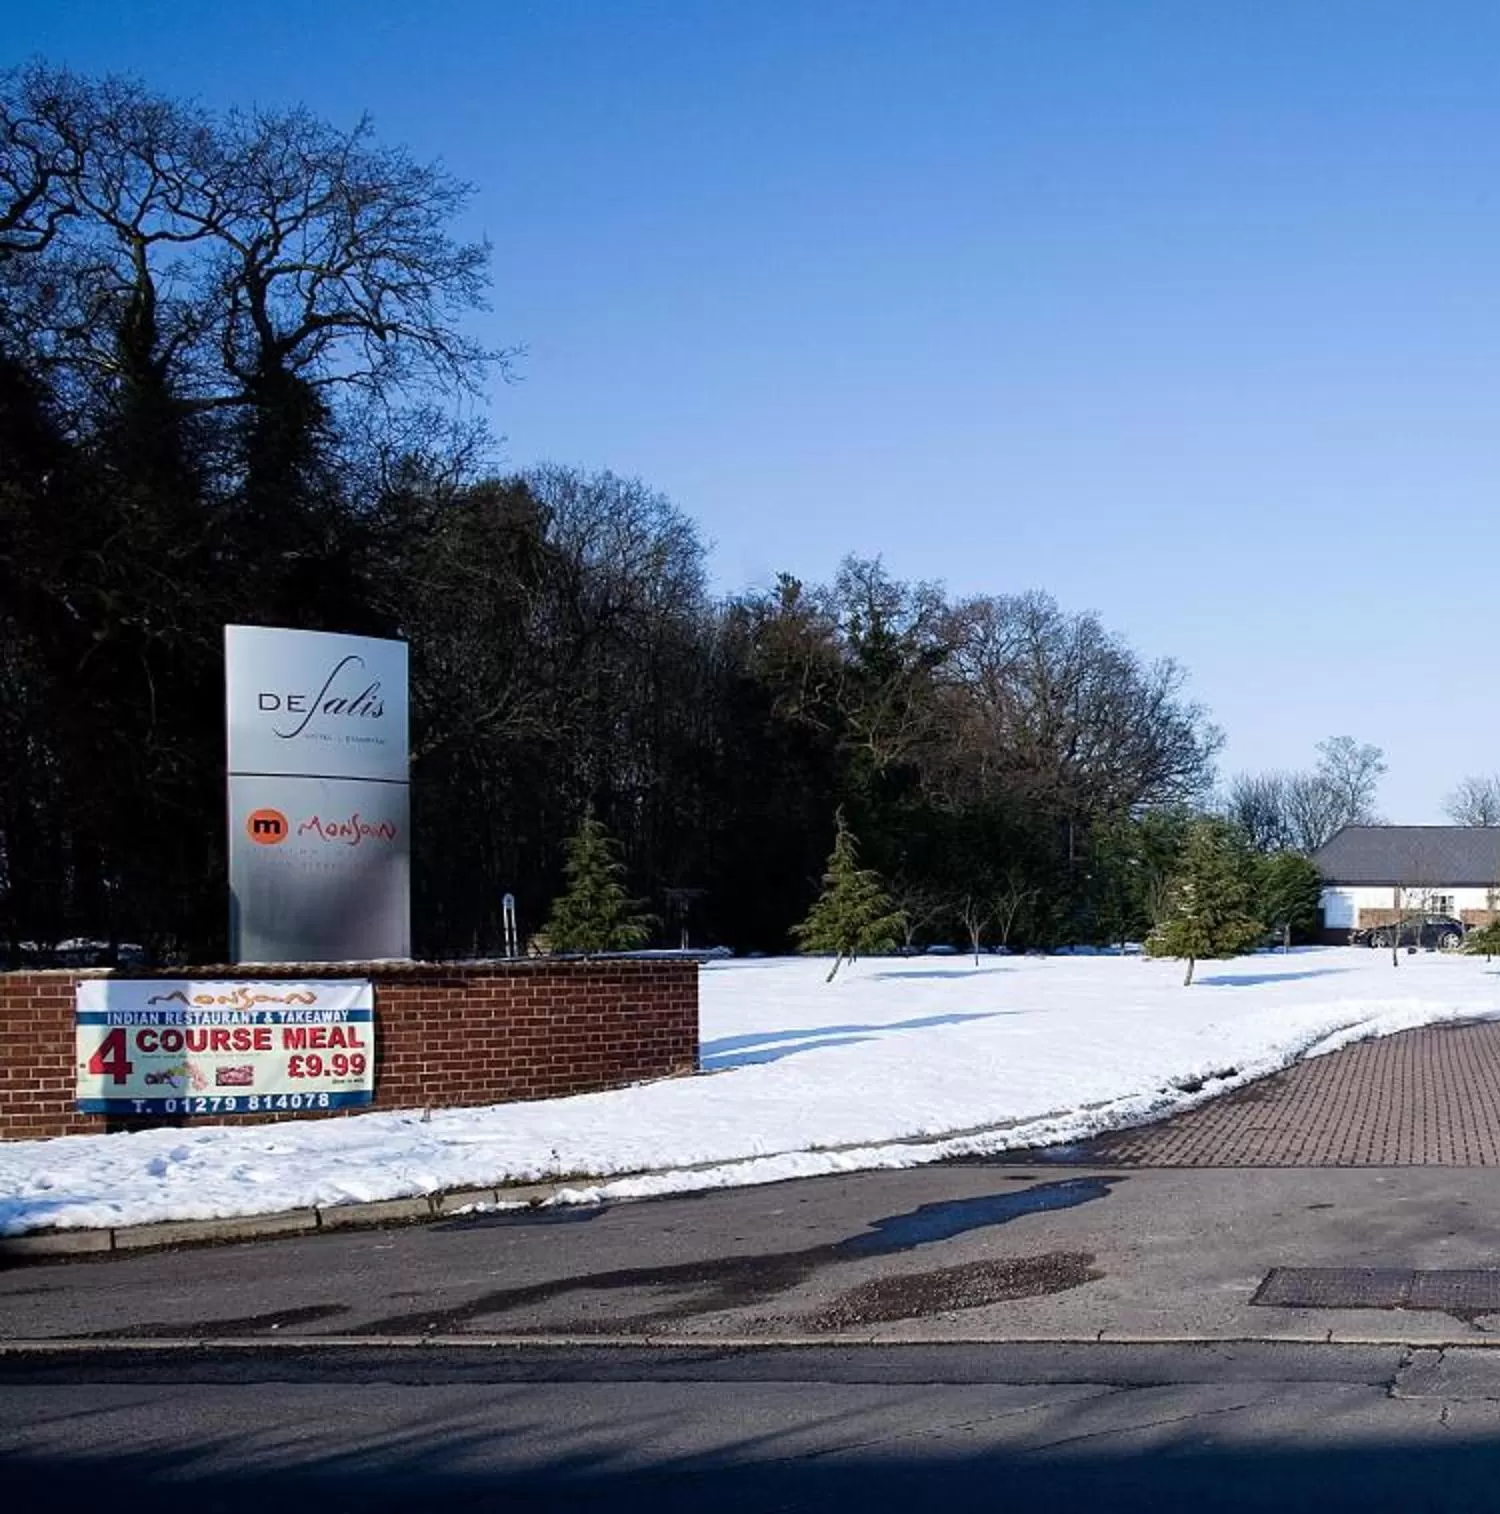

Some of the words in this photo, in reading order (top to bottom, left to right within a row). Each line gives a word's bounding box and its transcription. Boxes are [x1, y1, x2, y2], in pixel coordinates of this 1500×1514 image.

[106, 1011, 164, 1026] INDIAN
[165, 1011, 259, 1026] RESTAURANT
[263, 1010, 273, 1024] &
[278, 1008, 349, 1023] TAKEAWAY
[88, 1027, 133, 1085] 4
[135, 1027, 273, 1053] COURSE
[283, 1025, 366, 1050] MEAL
[287, 1053, 368, 1079] £9.99
[131, 1099, 152, 1115] T.
[164, 1096, 238, 1114] 01279
[248, 1092, 330, 1111] 814078
